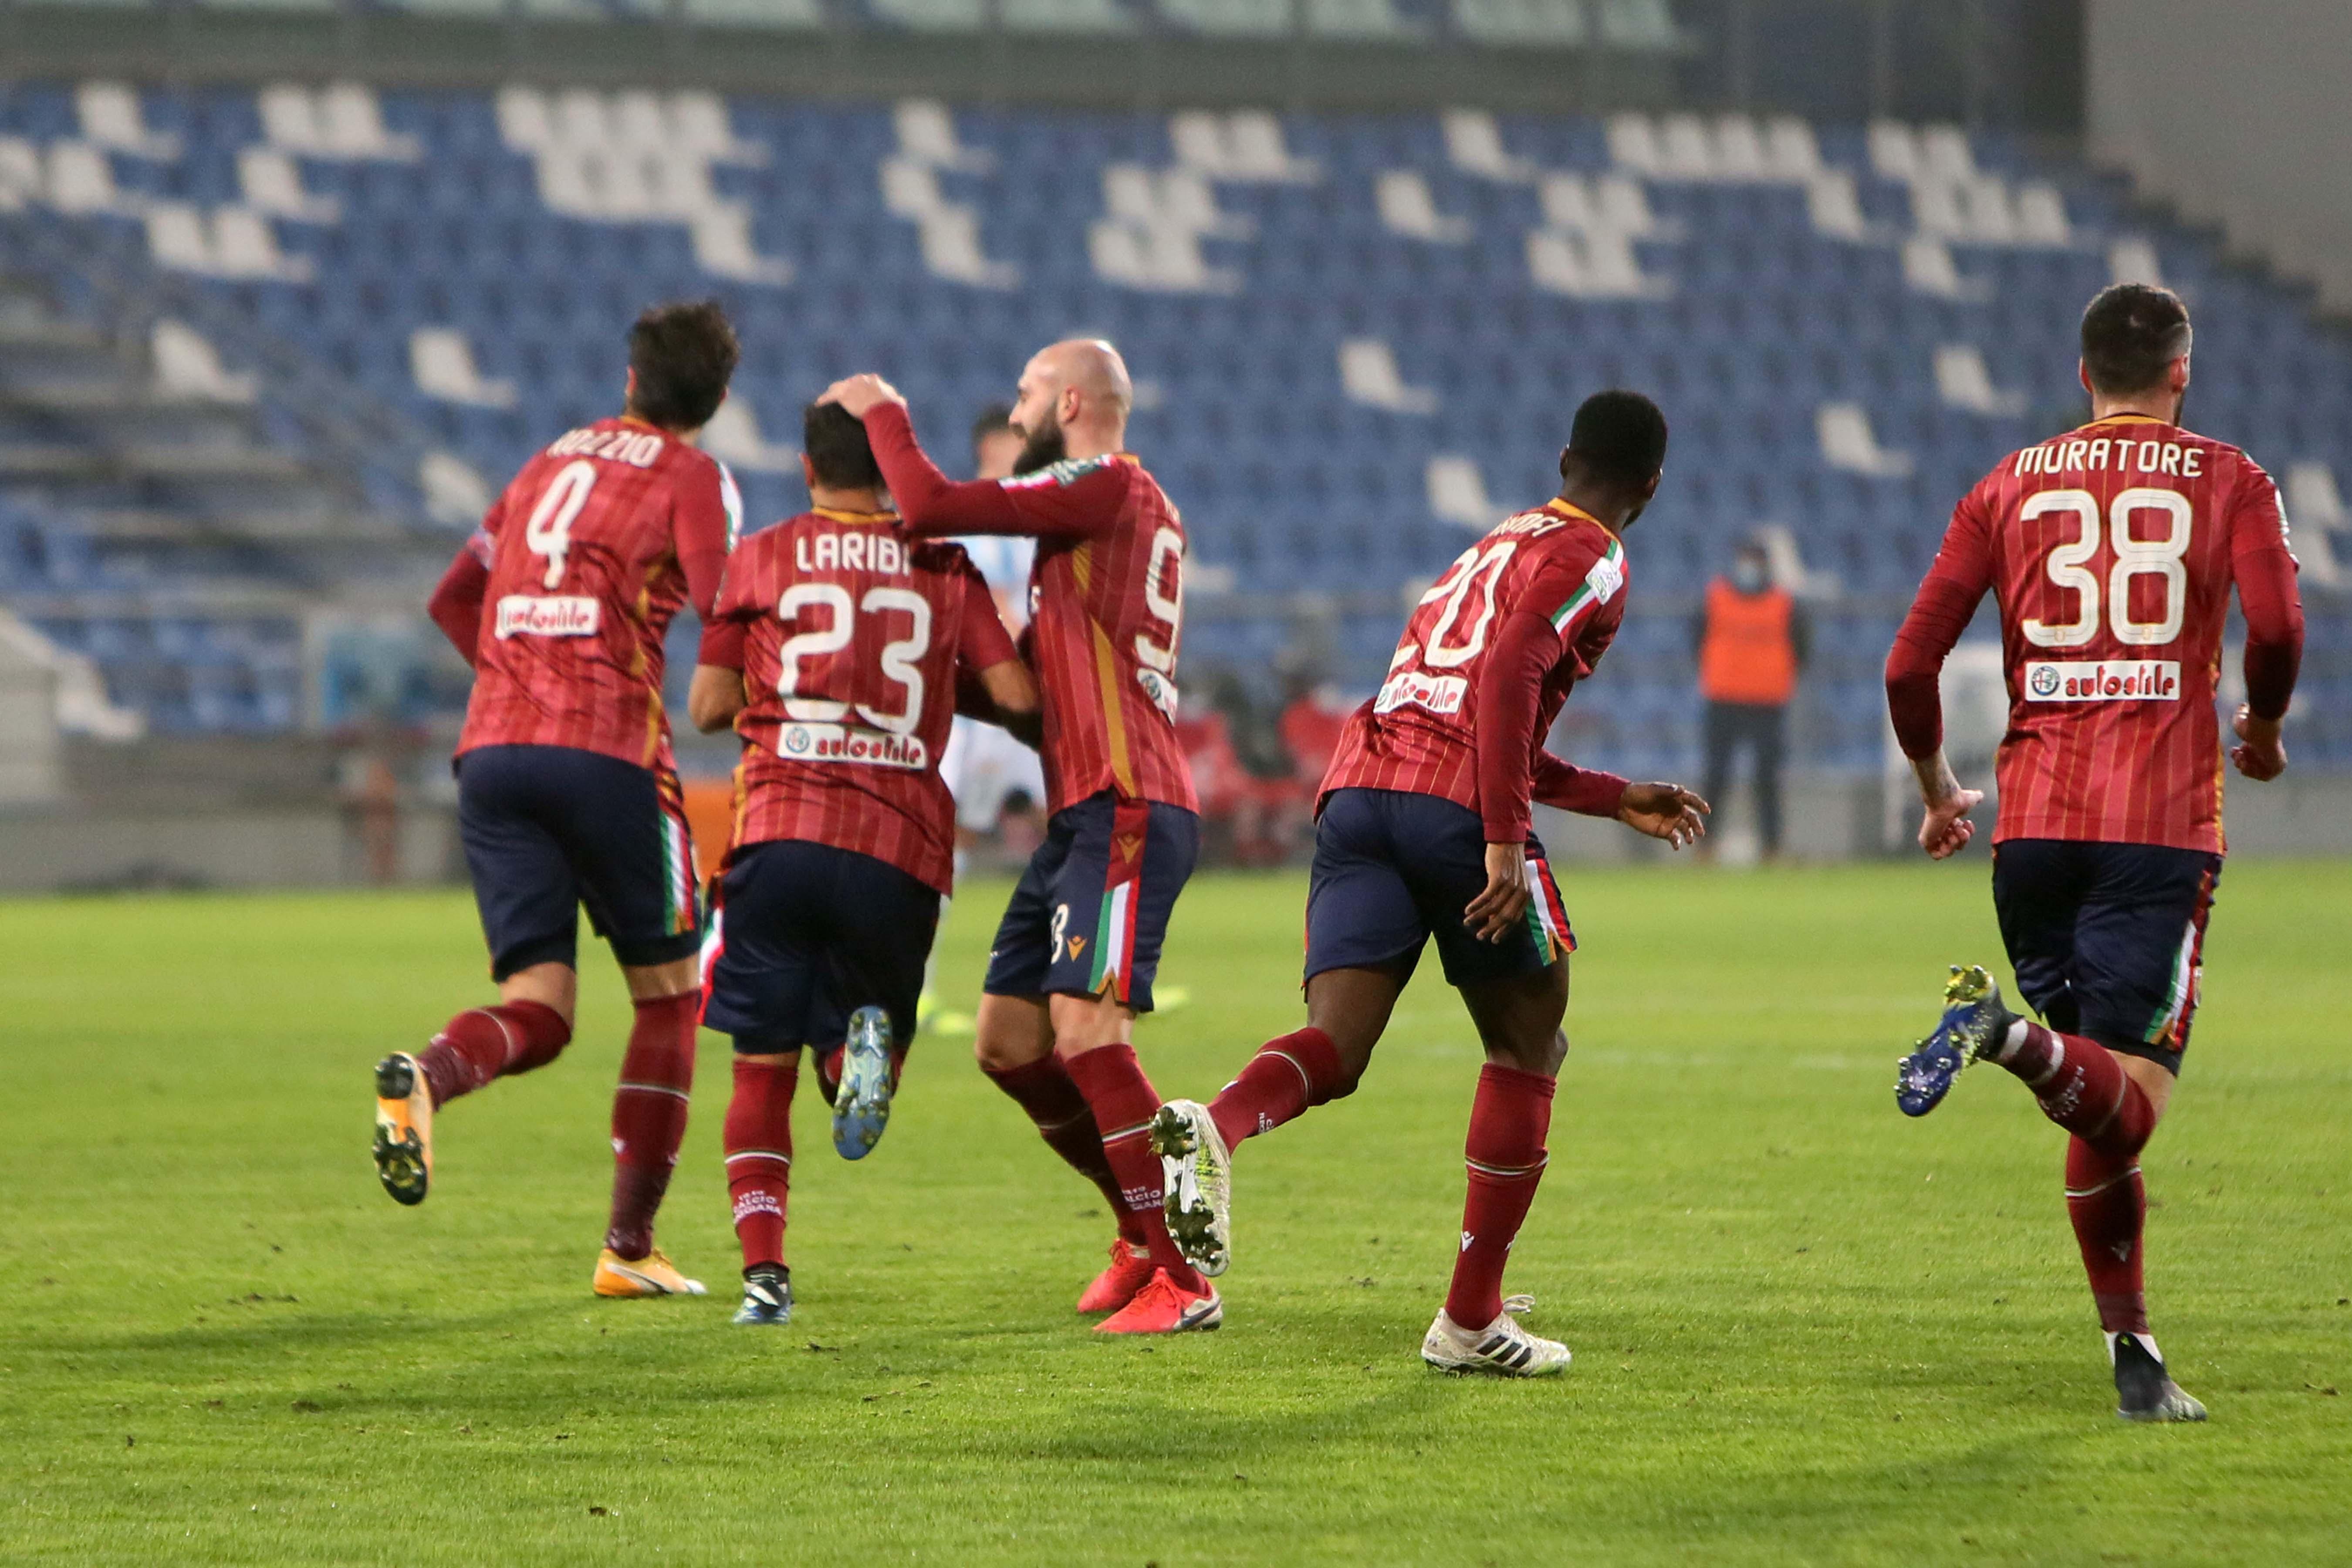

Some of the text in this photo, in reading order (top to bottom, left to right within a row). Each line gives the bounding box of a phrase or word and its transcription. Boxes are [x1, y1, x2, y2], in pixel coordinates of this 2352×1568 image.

[2015, 439, 2204, 477] MURATORE
[1389, 540, 1517, 668] 20
[2020, 487, 2193, 648] 38
[777, 583, 932, 736] 23
[2066, 664, 2174, 697] autostile
